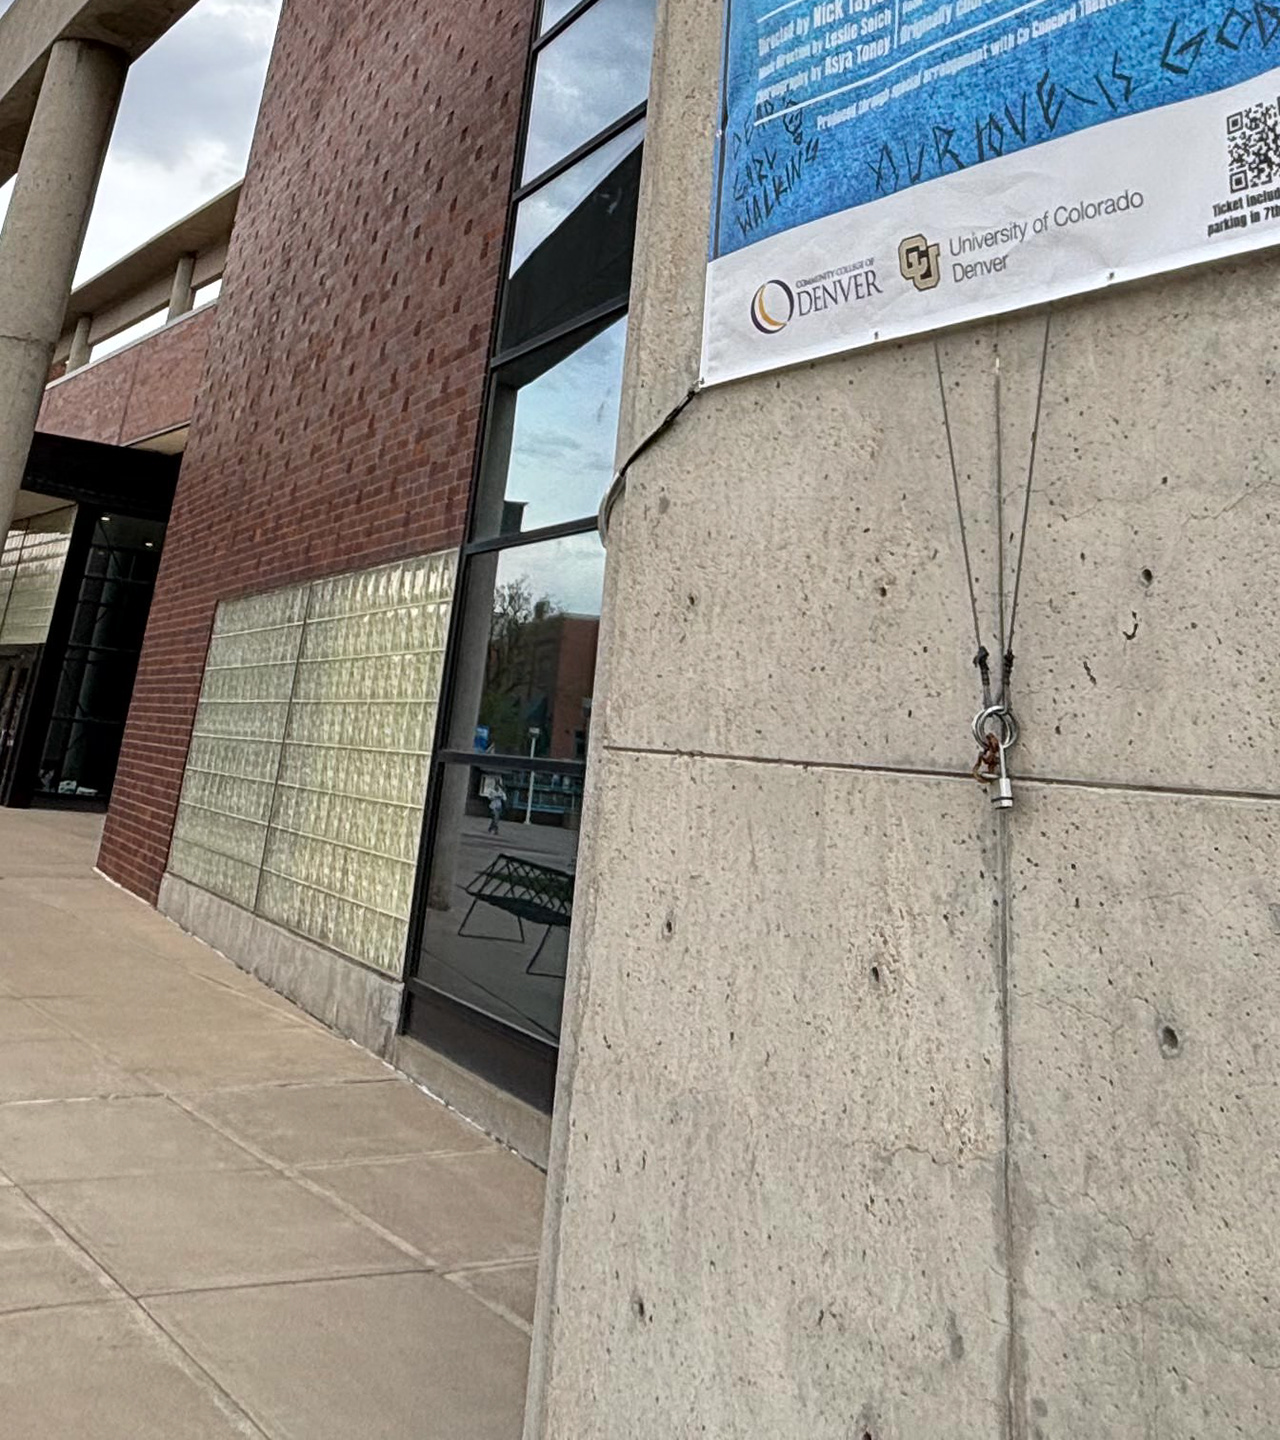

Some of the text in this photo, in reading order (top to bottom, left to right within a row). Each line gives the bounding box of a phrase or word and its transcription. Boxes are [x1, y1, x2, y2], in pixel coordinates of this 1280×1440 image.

[796, 17, 809, 36] by
[825, 24, 857, 48] Leslie
[824, 52, 852, 76] Asya
[856, 35, 889, 63] Toney
[951, 185, 1143, 258] University of Colorado
[1211, 197, 1244, 218] Ticket
[1207, 214, 1248, 238] parking
[1250, 209, 1261, 223] in
[796, 269, 834, 289] COMMUNITY
[835, 259, 865, 277] COLLEGE
[953, 253, 1007, 284] Denver
[796, 267, 882, 318] DENVER
